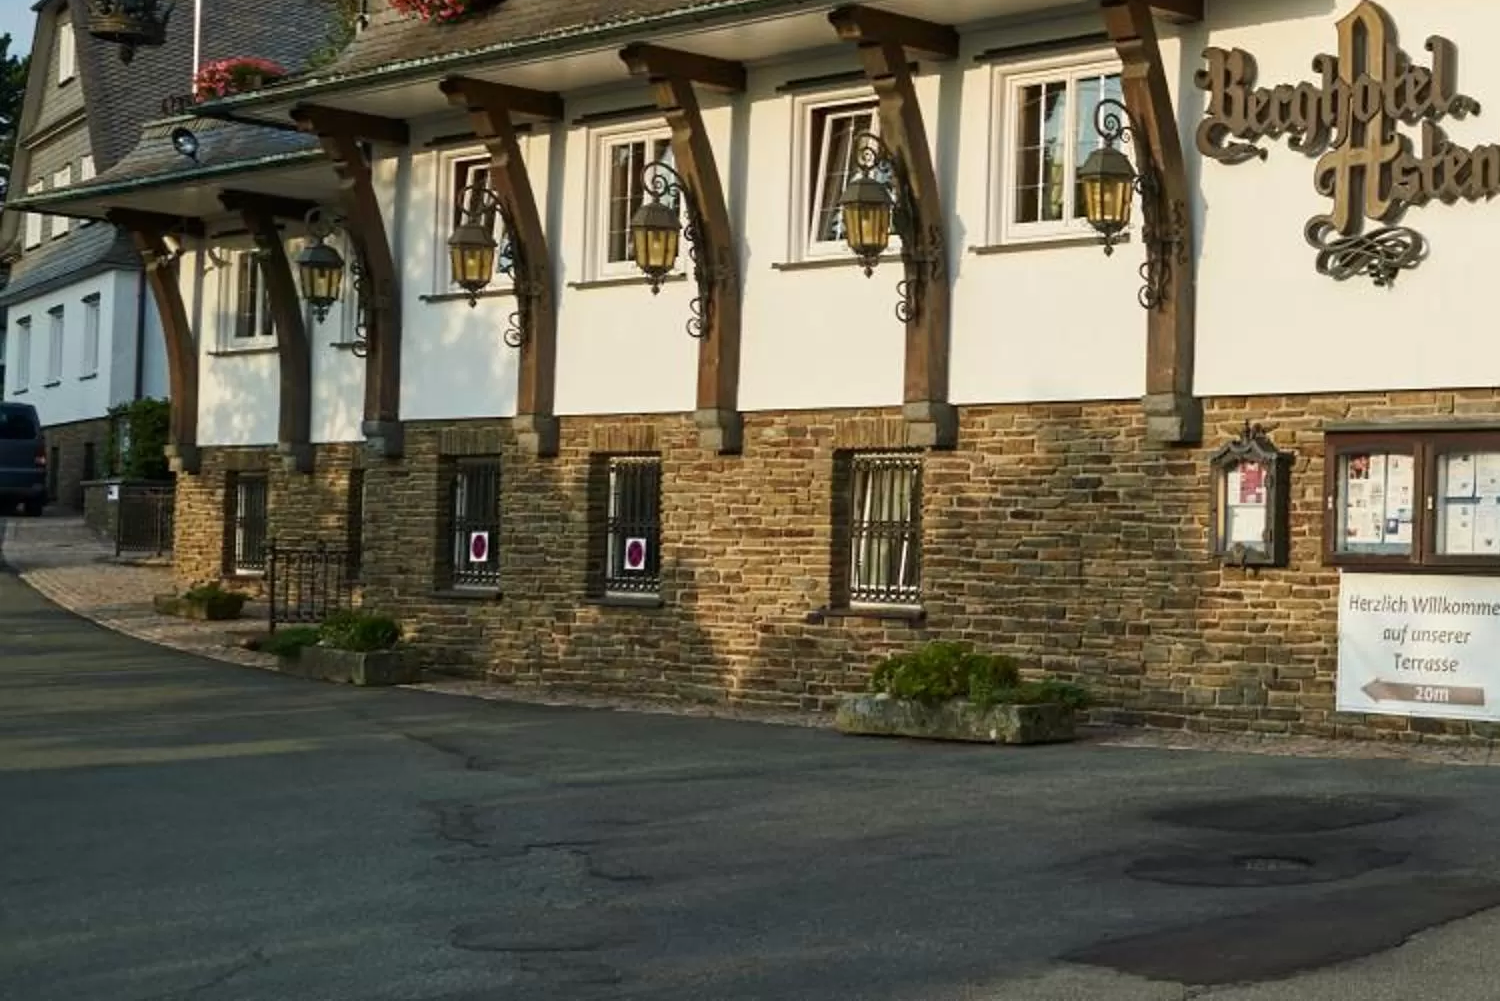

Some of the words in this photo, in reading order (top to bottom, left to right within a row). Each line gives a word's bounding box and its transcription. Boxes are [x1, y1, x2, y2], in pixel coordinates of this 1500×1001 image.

[1195, 34, 1481, 165] Berghotel
[1349, 595, 1407, 613] Herzlich
[1383, 624, 1408, 646] auf
[1411, 628, 1472, 645] unserer
[1393, 652, 1460, 673] Terrasse
[1415, 686, 1449, 702] 20m
